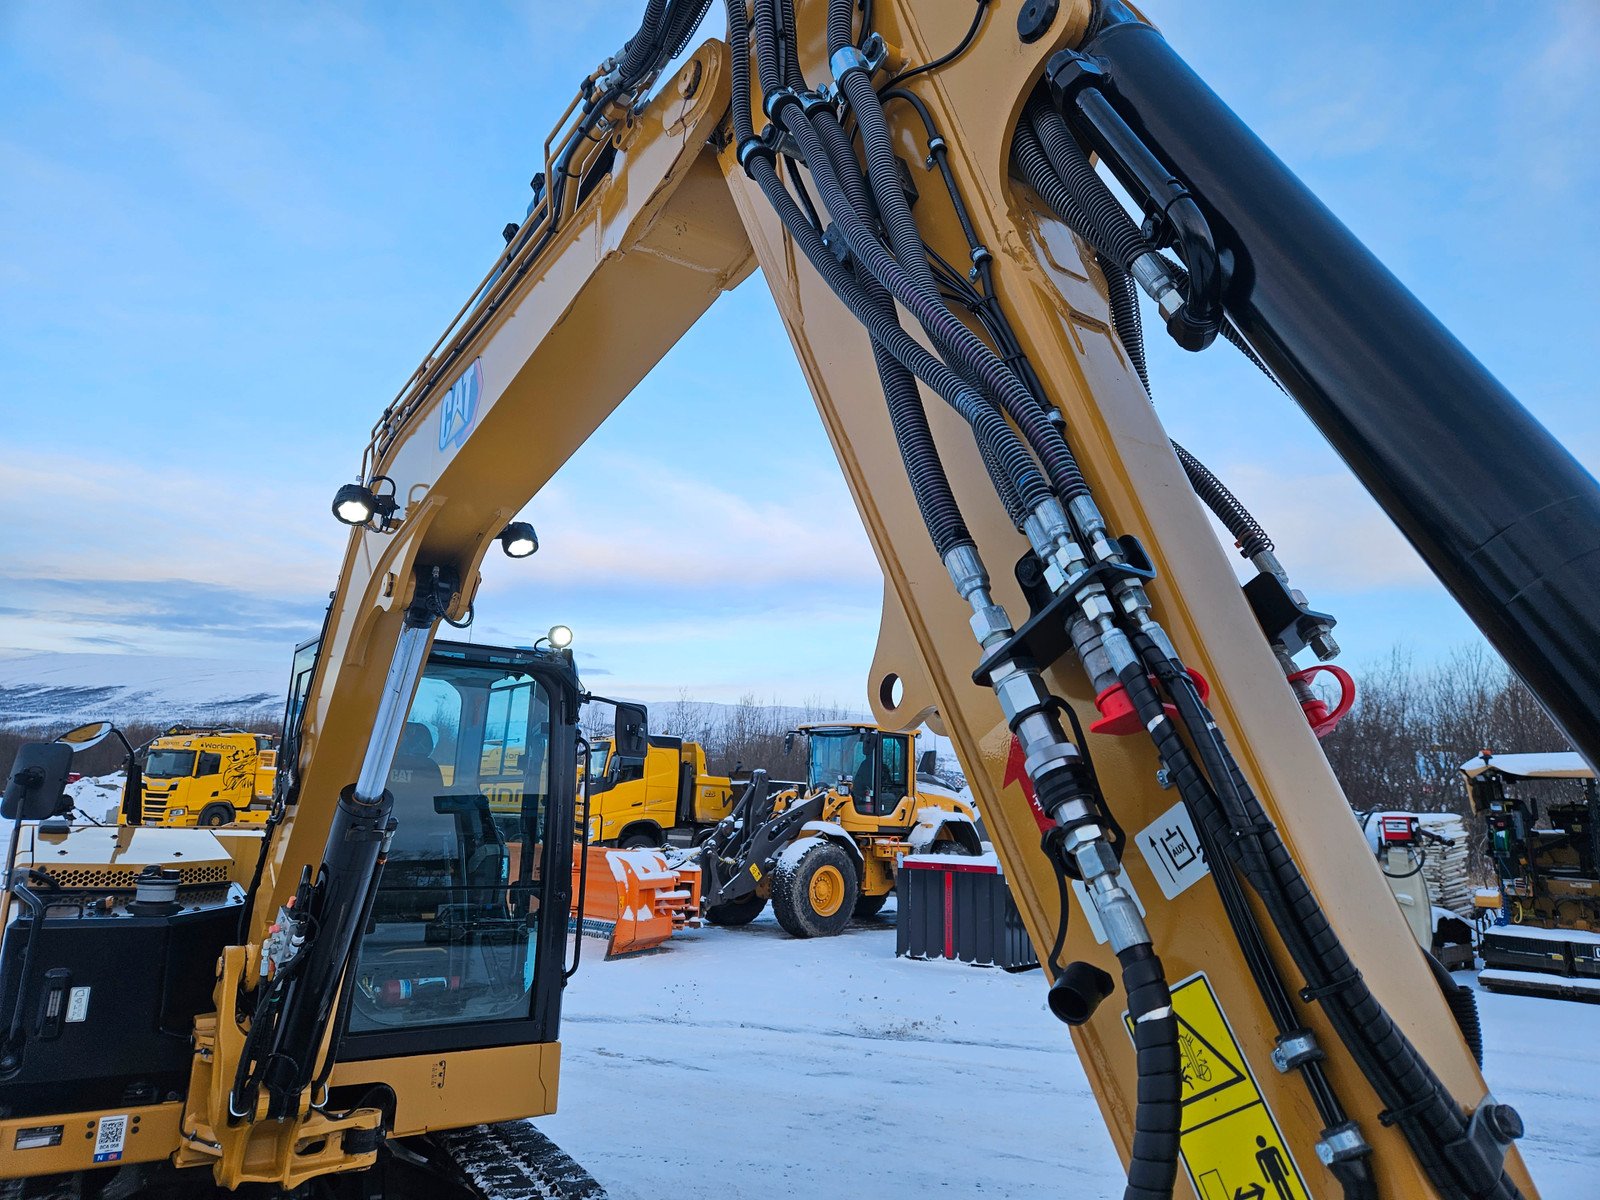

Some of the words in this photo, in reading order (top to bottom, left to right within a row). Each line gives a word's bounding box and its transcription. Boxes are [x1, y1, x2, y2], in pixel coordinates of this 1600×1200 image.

[439, 362, 475, 450] CAT
[204, 742, 237, 751] Workinn
[390, 769, 413, 783] CAT
[1172, 842, 1187, 858] AUX
